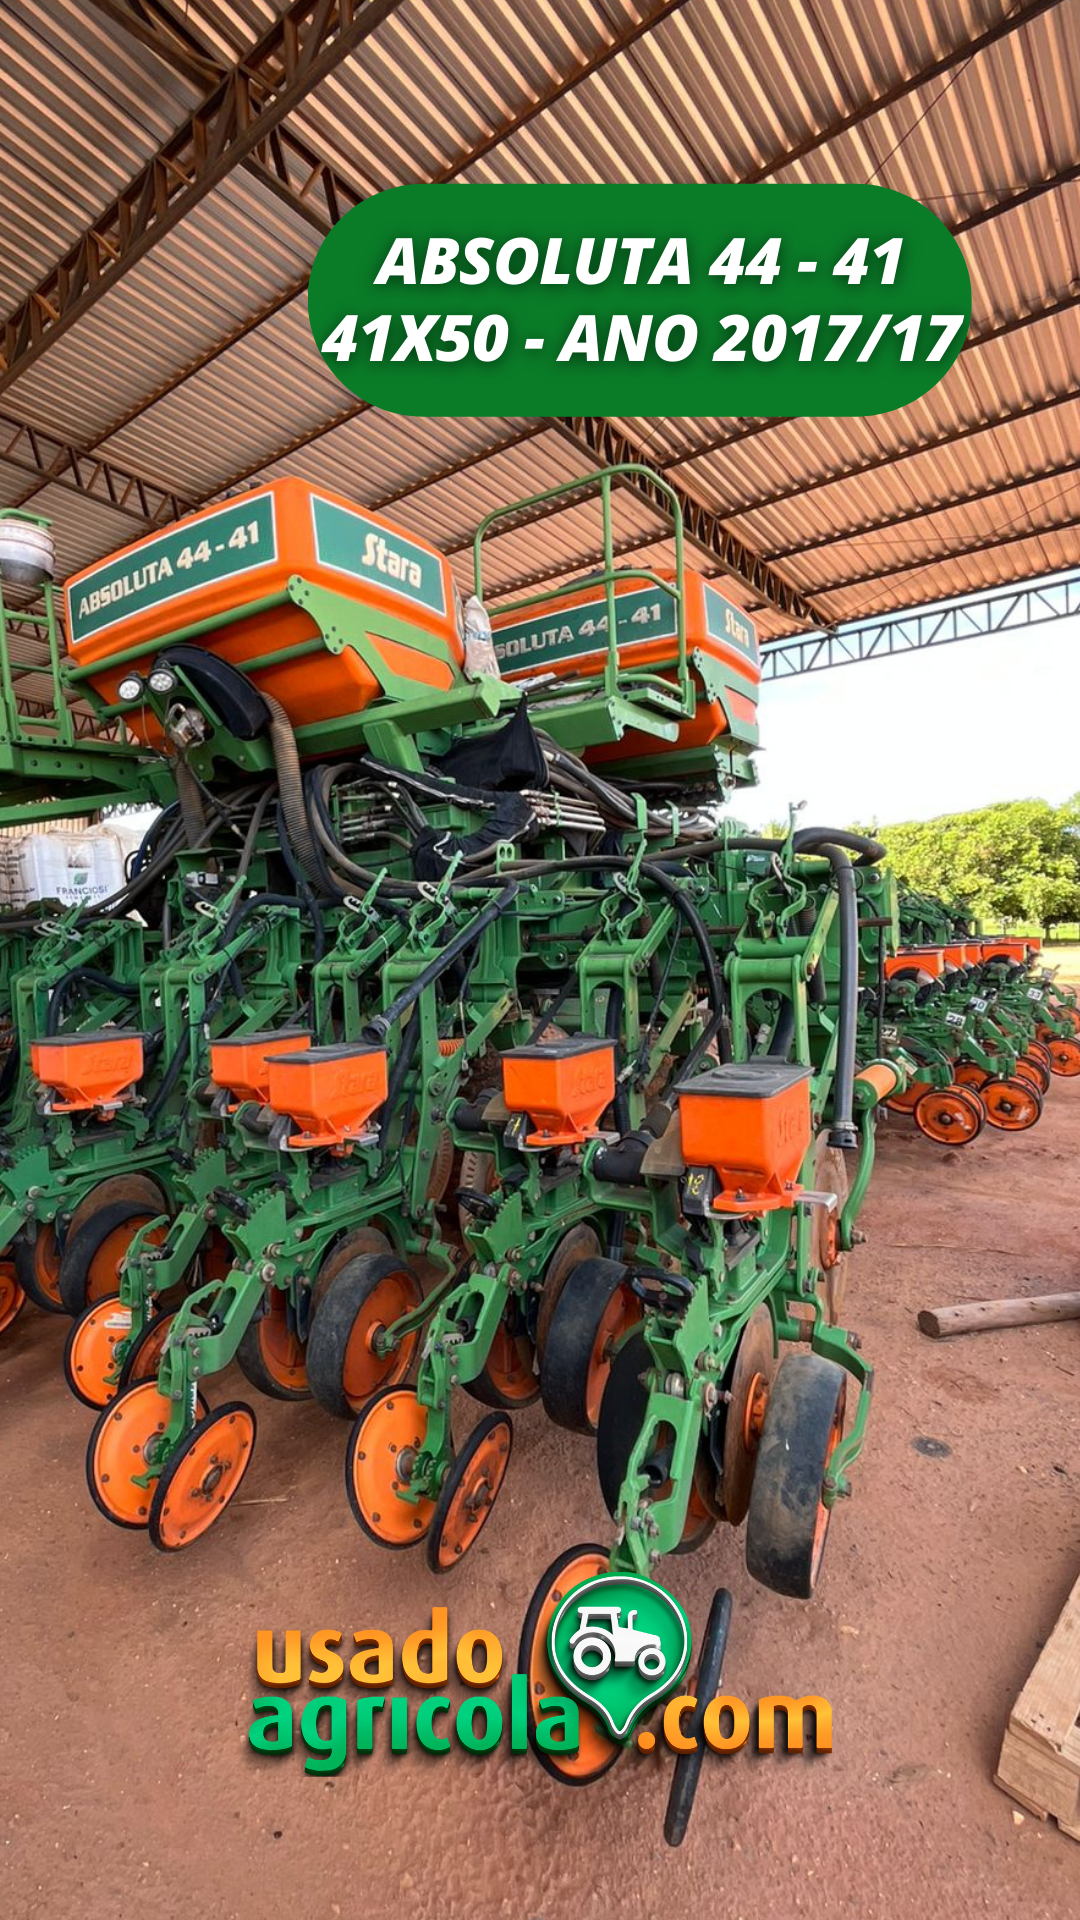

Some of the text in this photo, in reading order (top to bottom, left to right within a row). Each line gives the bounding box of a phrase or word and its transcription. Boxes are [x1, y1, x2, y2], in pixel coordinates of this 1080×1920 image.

[78, 520, 259, 619] ABSOLUTA 44 - 41
[361, 532, 422, 589] Stara
[578, 615, 609, 637] 44
[631, 603, 661, 625] 41
[725, 607, 749, 648] Stara
[56, 885, 108, 895] FRANCIOSI
[947, 1013, 963, 1027] 28
